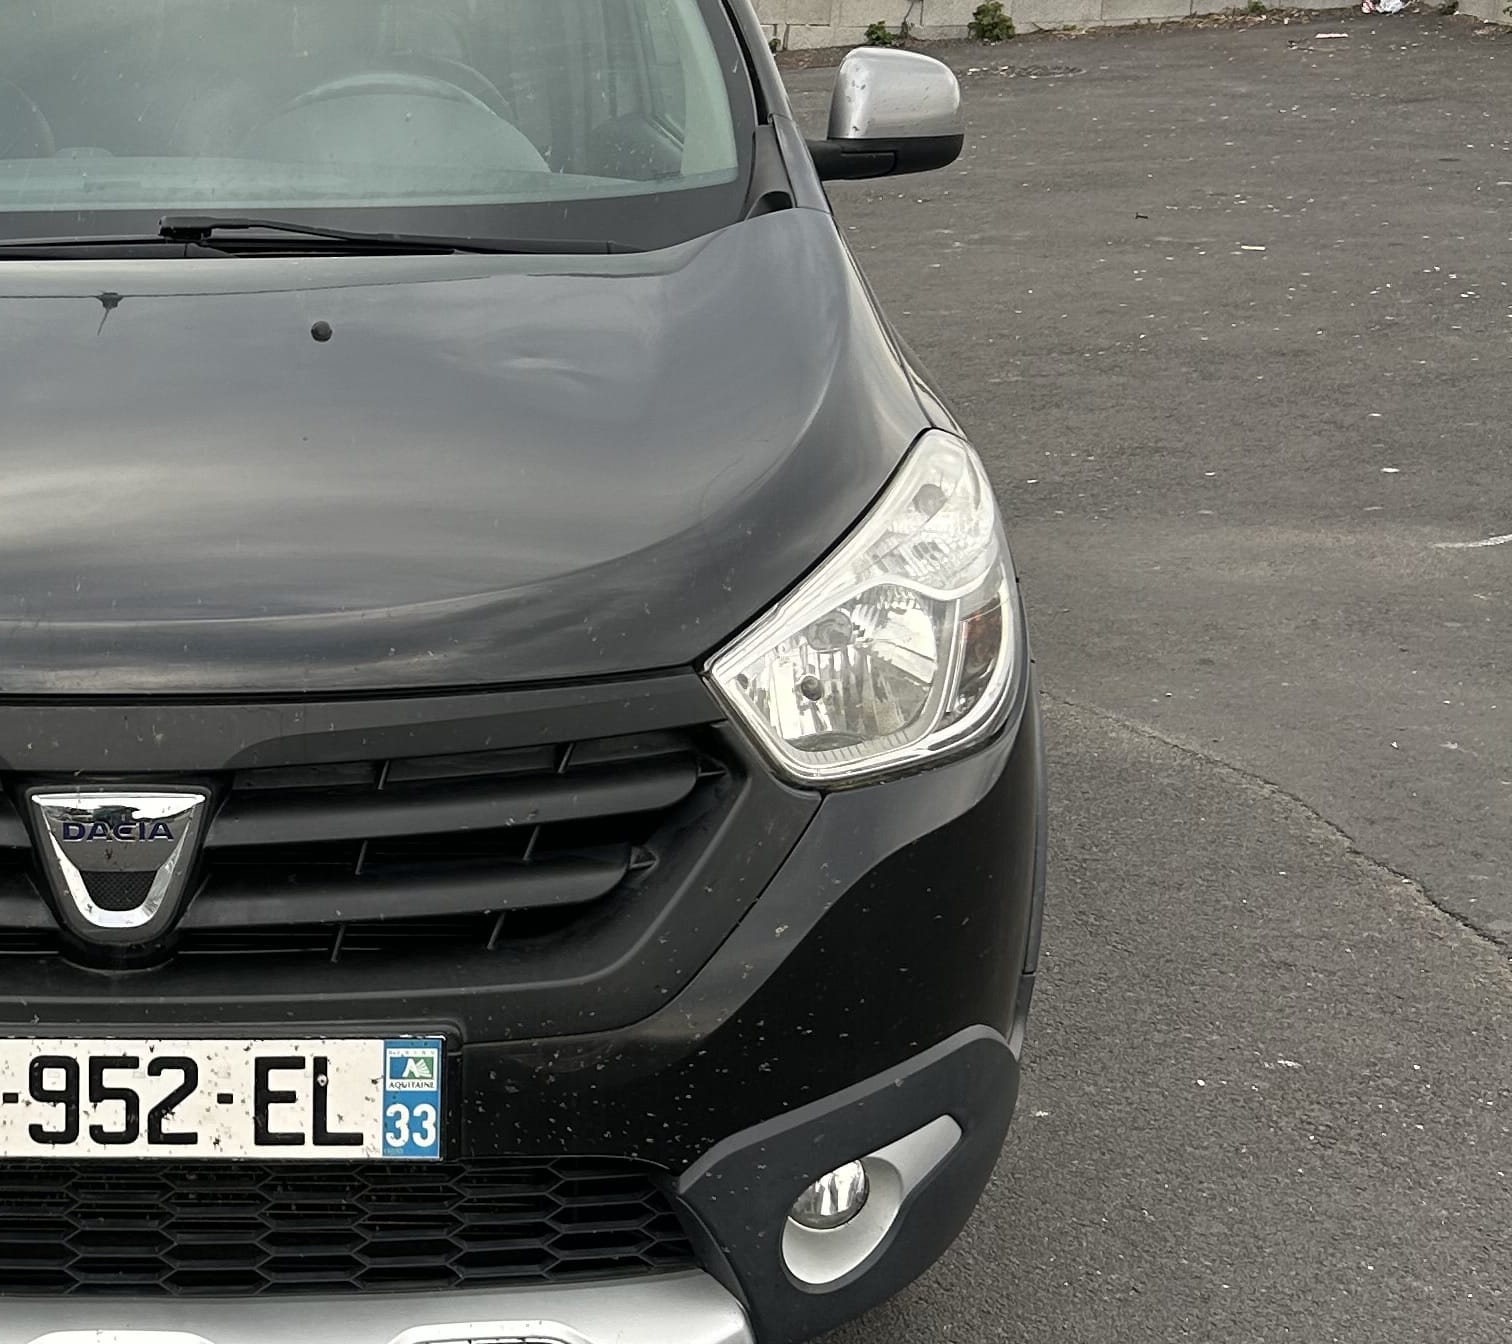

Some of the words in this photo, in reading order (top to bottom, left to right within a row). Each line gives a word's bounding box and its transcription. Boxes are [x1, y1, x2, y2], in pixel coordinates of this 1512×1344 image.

[62, 822, 175, 842] DACIA
[390, 1081, 434, 1090] AQUITAINE
[385, 1103, 437, 1147] 33
